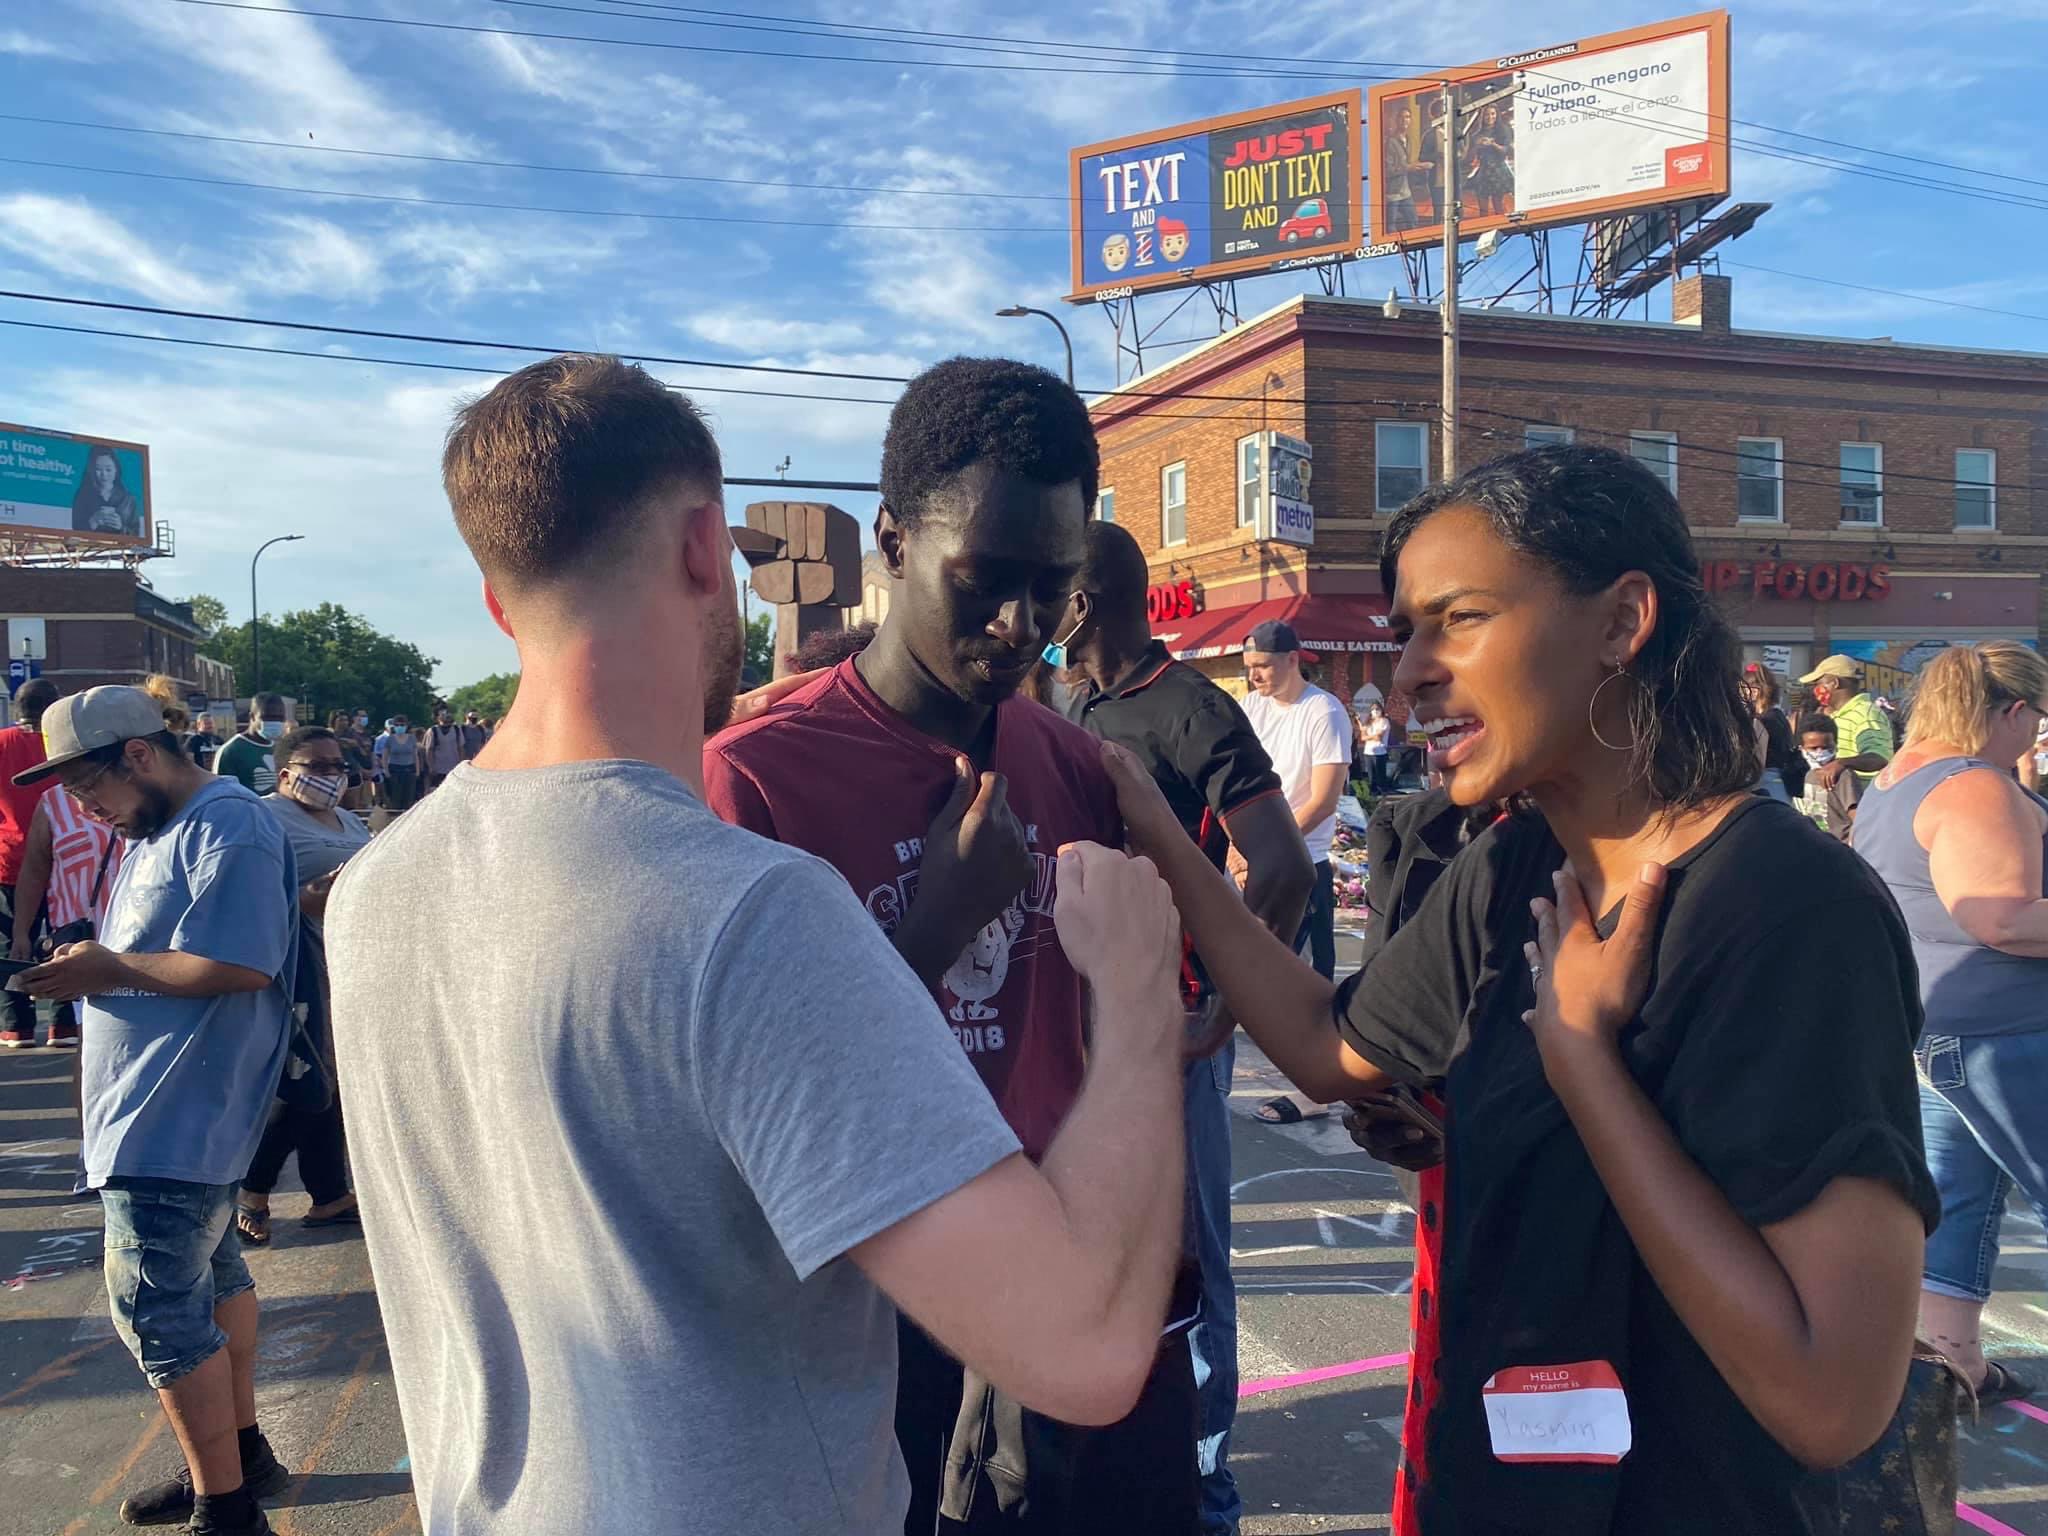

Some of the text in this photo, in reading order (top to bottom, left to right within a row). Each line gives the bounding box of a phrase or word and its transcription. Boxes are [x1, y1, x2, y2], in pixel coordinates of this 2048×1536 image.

[1529, 62, 1672, 100] Fulano, mengano
[1528, 117, 1566, 132] Todos
[1570, 113, 1579, 124] a
[1622, 100, 1635, 113] el
[1529, 94, 1601, 119] y zutana.
[1224, 122, 1333, 166] JUST
[1099, 152, 1186, 214] TEXT
[1224, 150, 1333, 210] DON'T TEXT
[1132, 208, 1156, 228] AND
[1242, 205, 1278, 231] AND
[1355, 242, 1398, 260] 032570
[1095, 286, 1133, 302] 032540
[12, 439, 46, 456] time
[18, 453, 75, 476] healthy.
[1277, 503, 1312, 530] metro
[1754, 561, 1891, 601] FOODS
[1299, 640, 1345, 651] MIDDLE
[1530, 1370, 1569, 1382] HELLO
[1541, 1382, 1569, 1391] name
[1571, 1380, 1580, 1388] is
